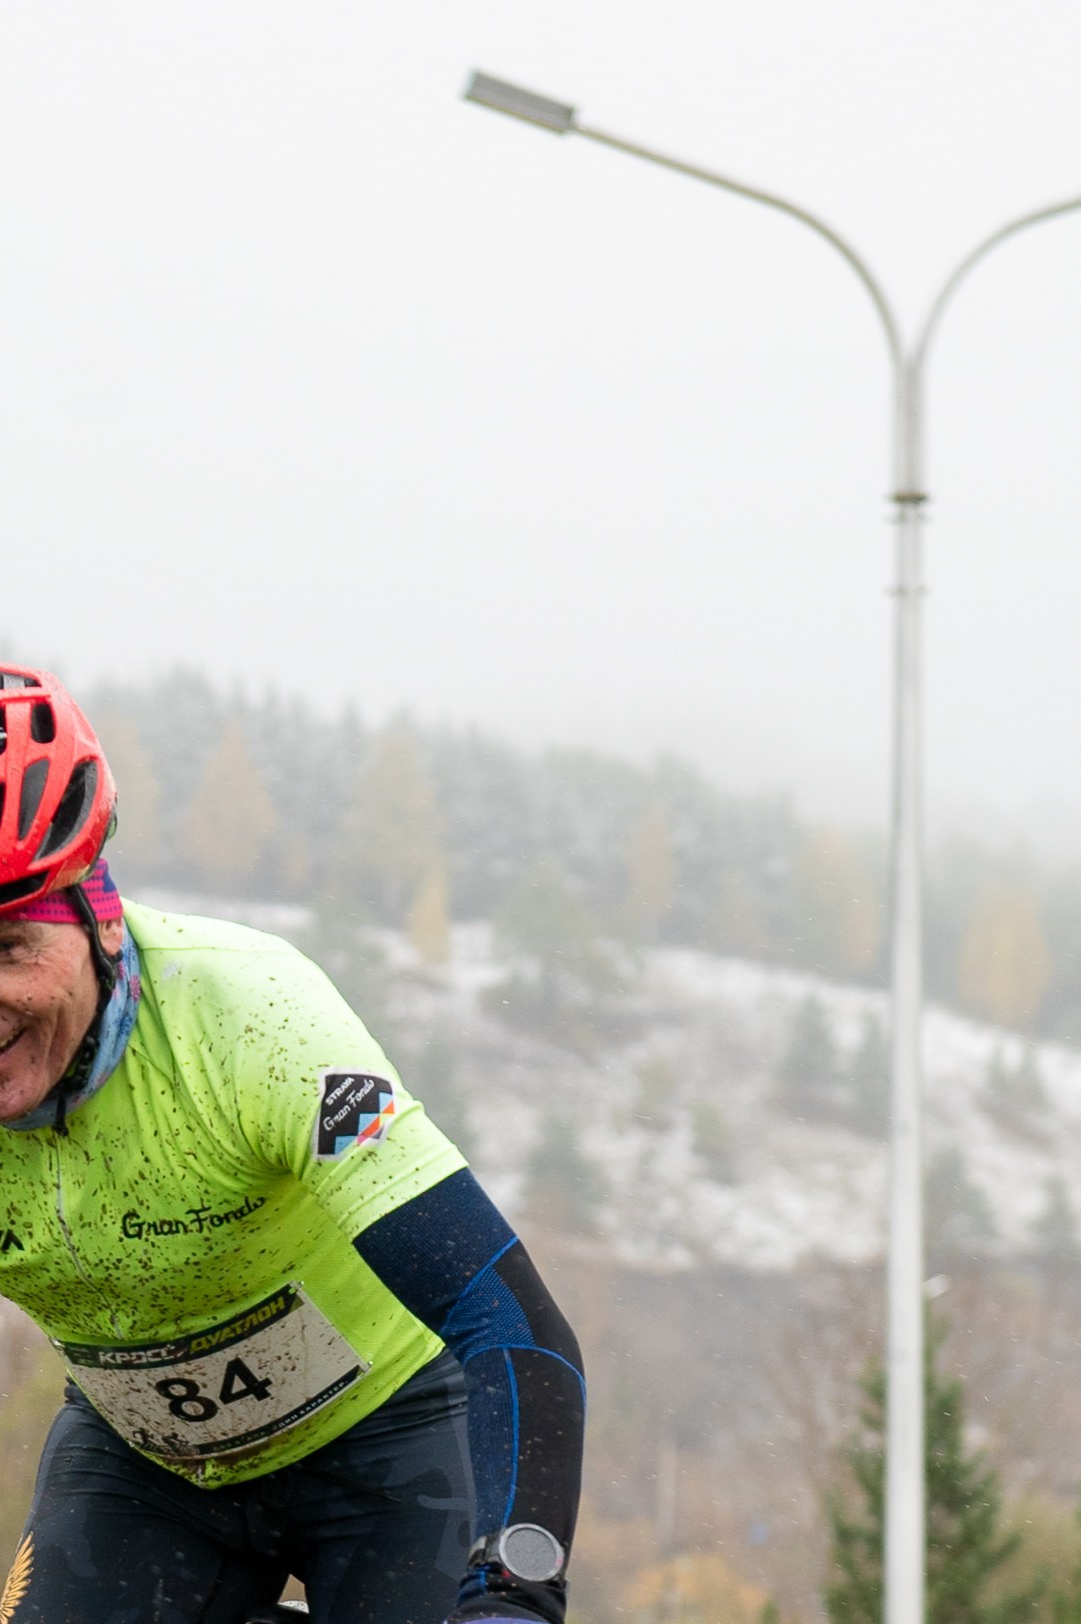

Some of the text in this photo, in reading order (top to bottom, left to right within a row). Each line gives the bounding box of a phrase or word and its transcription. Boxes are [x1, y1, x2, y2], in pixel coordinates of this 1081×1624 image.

[325, 1076, 355, 1106] STRAVA
[323, 1104, 351, 1131] Gran
[121, 1208, 188, 1239] Gran
[189, 1295, 286, 1355] ДУАТЛОН
[154, 1356, 273, 1423] 84
